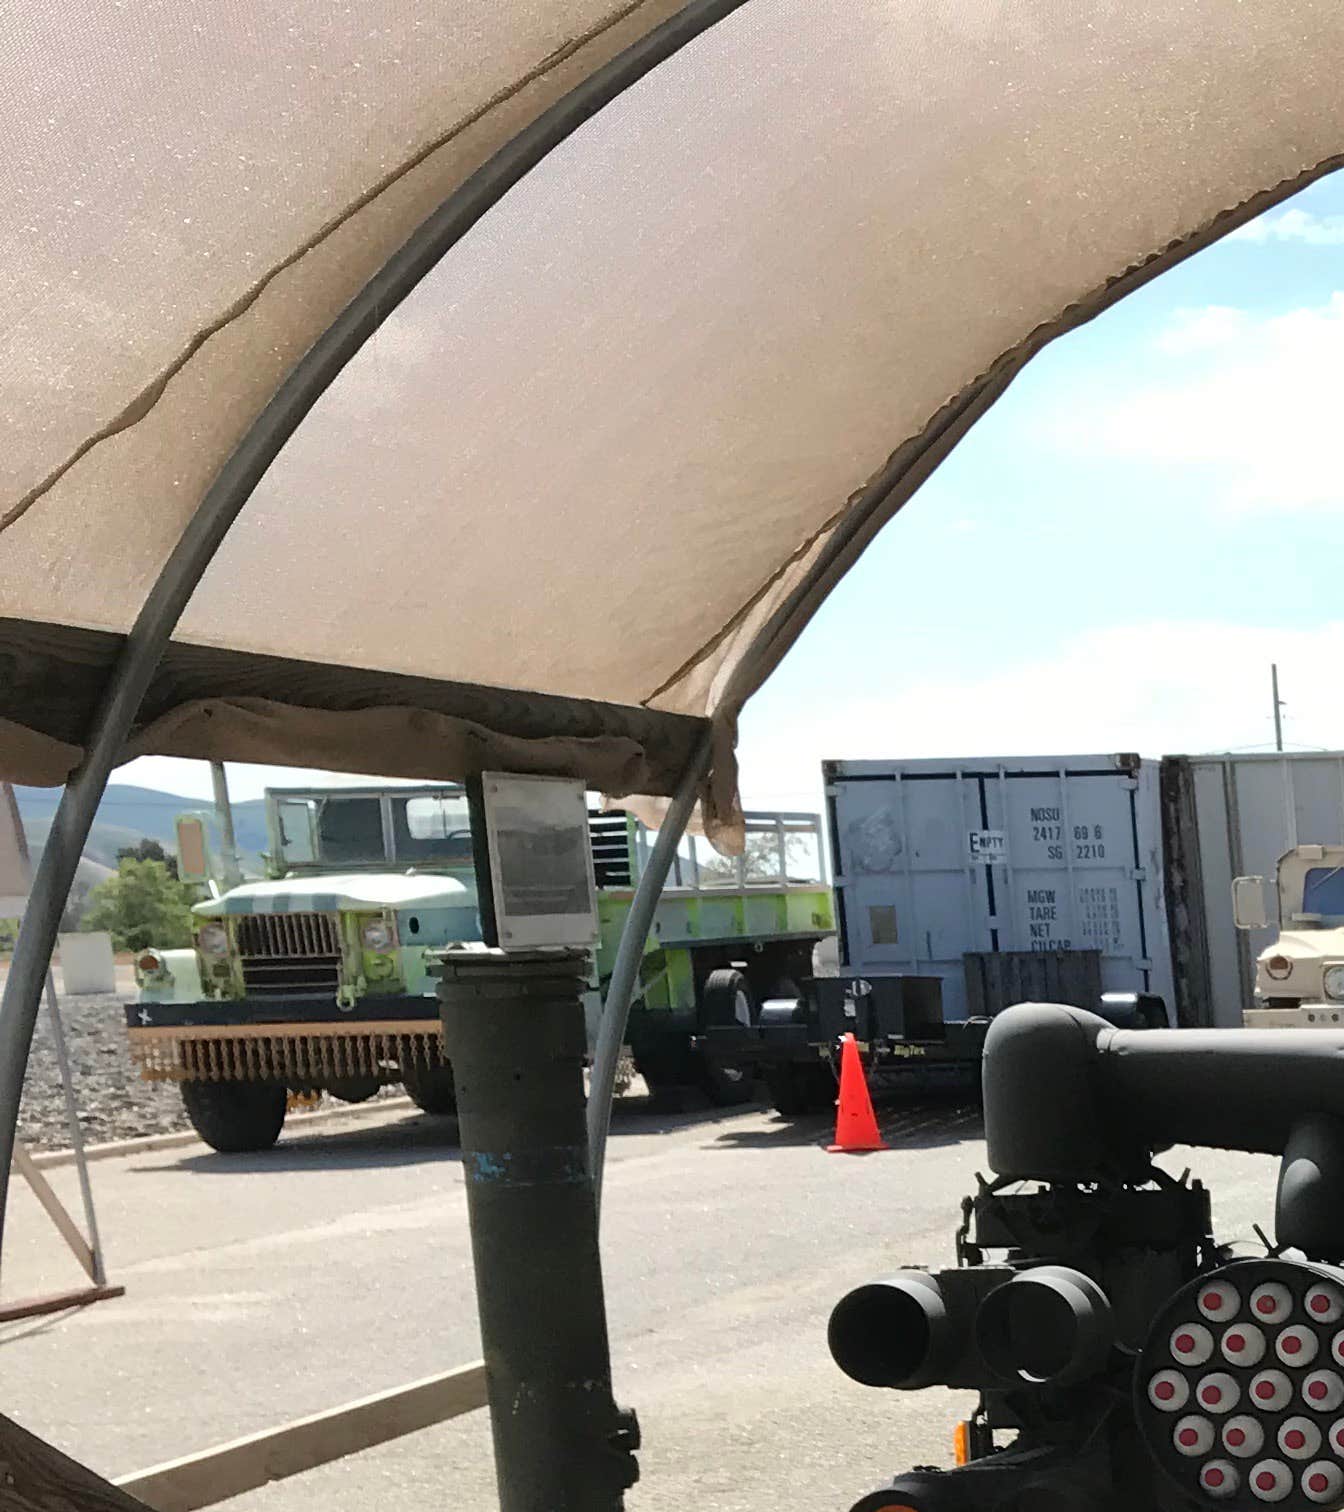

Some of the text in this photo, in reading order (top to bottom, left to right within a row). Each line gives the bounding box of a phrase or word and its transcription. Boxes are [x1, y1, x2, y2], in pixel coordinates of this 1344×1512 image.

[1030, 807, 1060, 821] NOSU
[1033, 826, 1061, 841] 2417
[1076, 844, 1105, 859] 2210
[1027, 889, 1056, 904] MGW
[1029, 906, 1057, 920] TARE
[1030, 922, 1050, 937] NET
